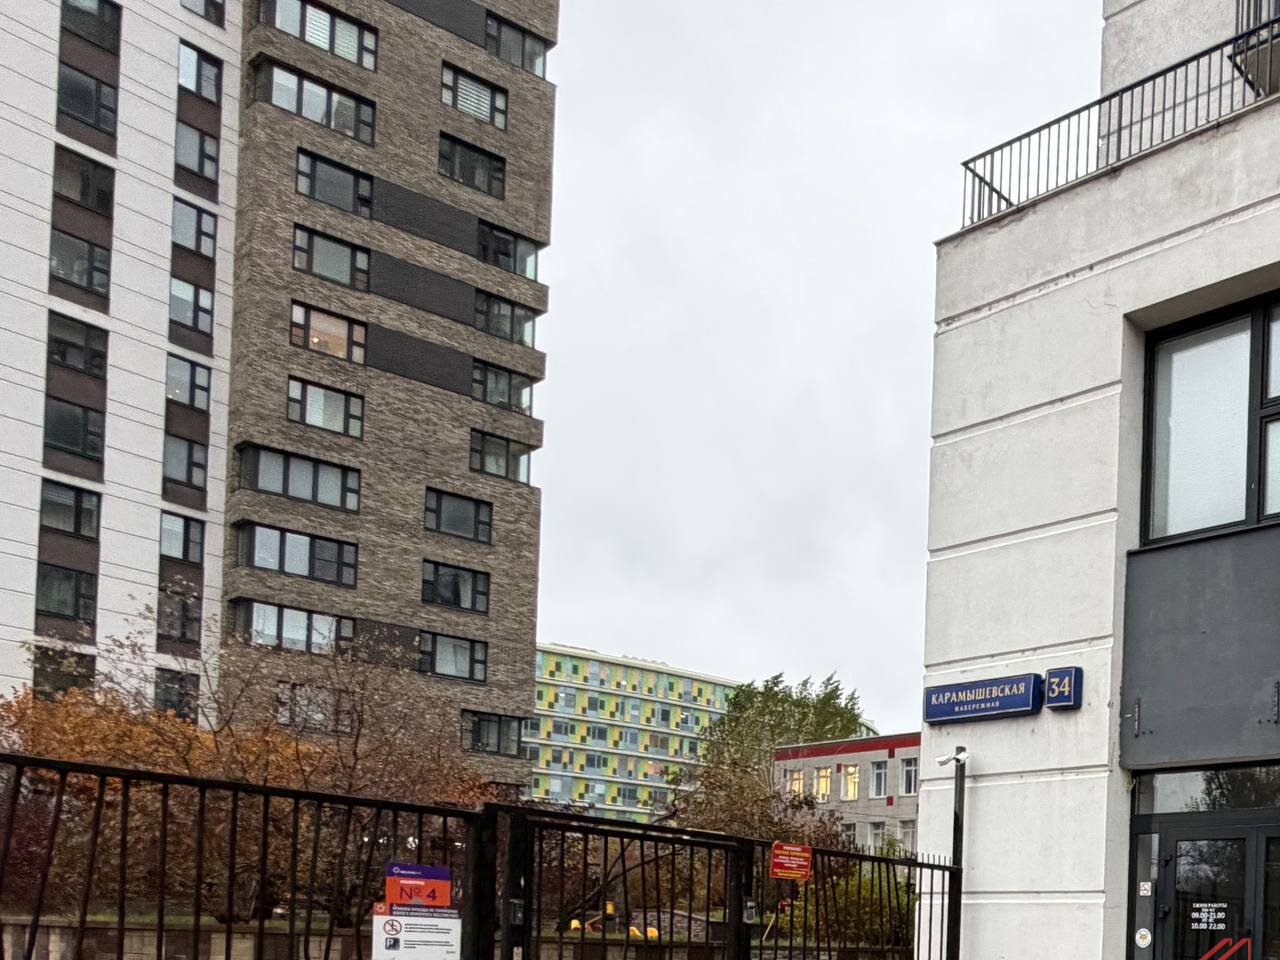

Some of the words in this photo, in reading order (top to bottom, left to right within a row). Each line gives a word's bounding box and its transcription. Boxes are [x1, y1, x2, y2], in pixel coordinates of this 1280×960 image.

[931, 682, 1026, 705] КАРАМЫШЕВСКАЯ
[1049, 677, 1070, 698] 34
[954, 701, 1000, 712] НАБЕРЕЖНАЯ
[426, 888, 437, 901] 4
